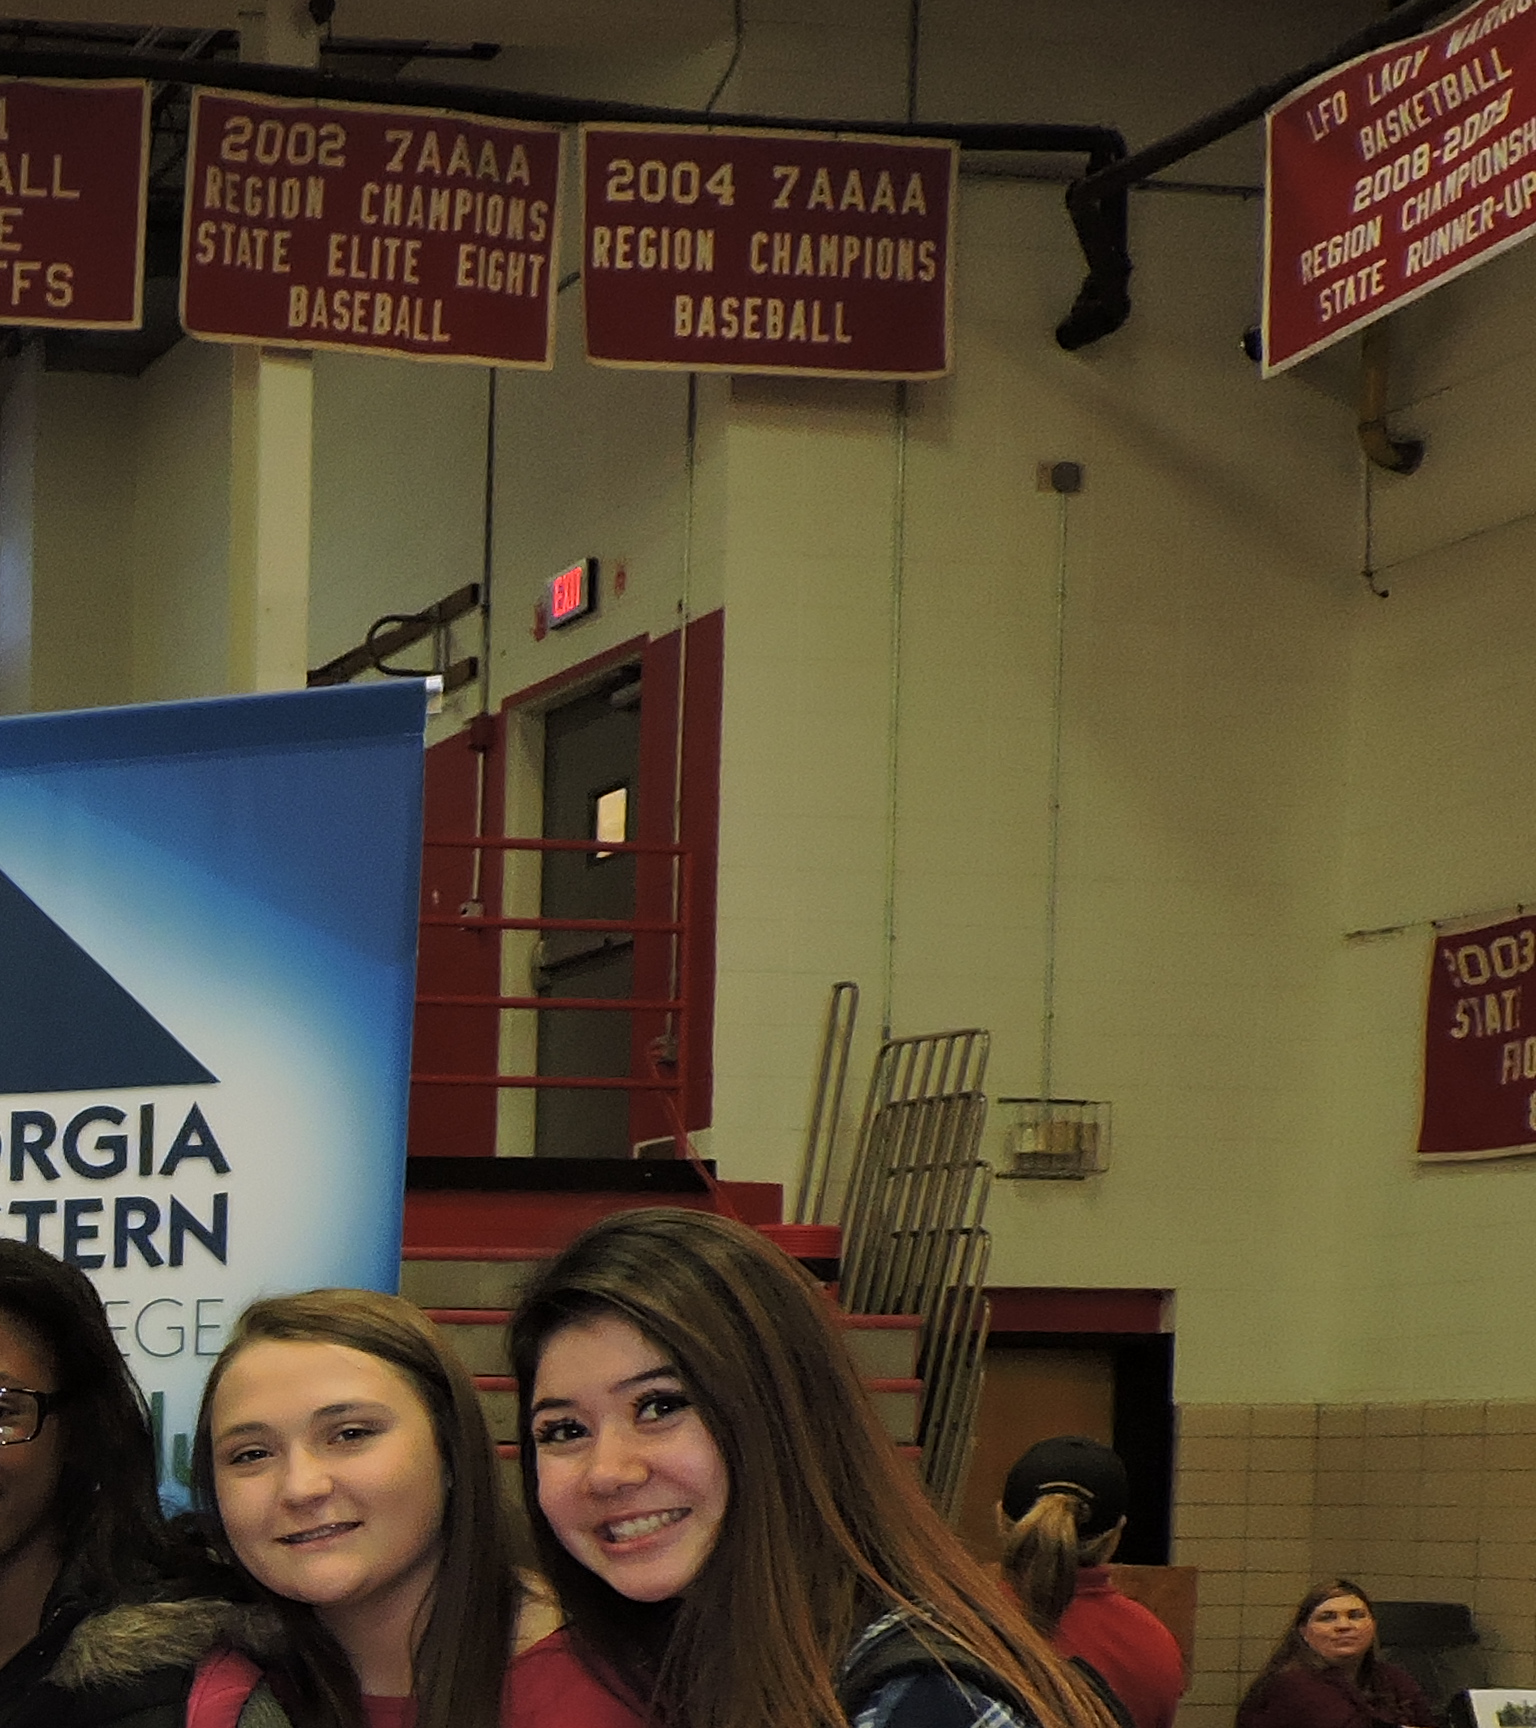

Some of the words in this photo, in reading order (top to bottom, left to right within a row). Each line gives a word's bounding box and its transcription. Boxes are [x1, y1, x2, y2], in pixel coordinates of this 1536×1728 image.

[1306, 90, 1348, 143] LFO
[1366, 46, 1429, 106] LADY
[1361, 47, 1513, 162] BASKETBALL
[220, 115, 347, 169] 2002
[384, 128, 531, 187] 7AAAA
[606, 158, 736, 208] 2004
[771, 164, 928, 216] 7AAAA
[1353, 88, 1514, 213] 2008-2009
[203, 165, 325, 221] REGION
[360, 182, 550, 244] CHAMPIONS
[196, 221, 292, 275] STATE
[326, 234, 422, 286] ELITE
[456, 240, 546, 299] EIGHT
[592, 226, 716, 273] REGION
[749, 230, 937, 282] CHAMPIONS
[1300, 215, 1383, 285] REGION
[1320, 259, 1387, 322] STATE
[1406, 170, 1536, 278] RUNNER-UP
[288, 284, 452, 345] BASEBALL
[674, 294, 853, 345] BASEBALL
